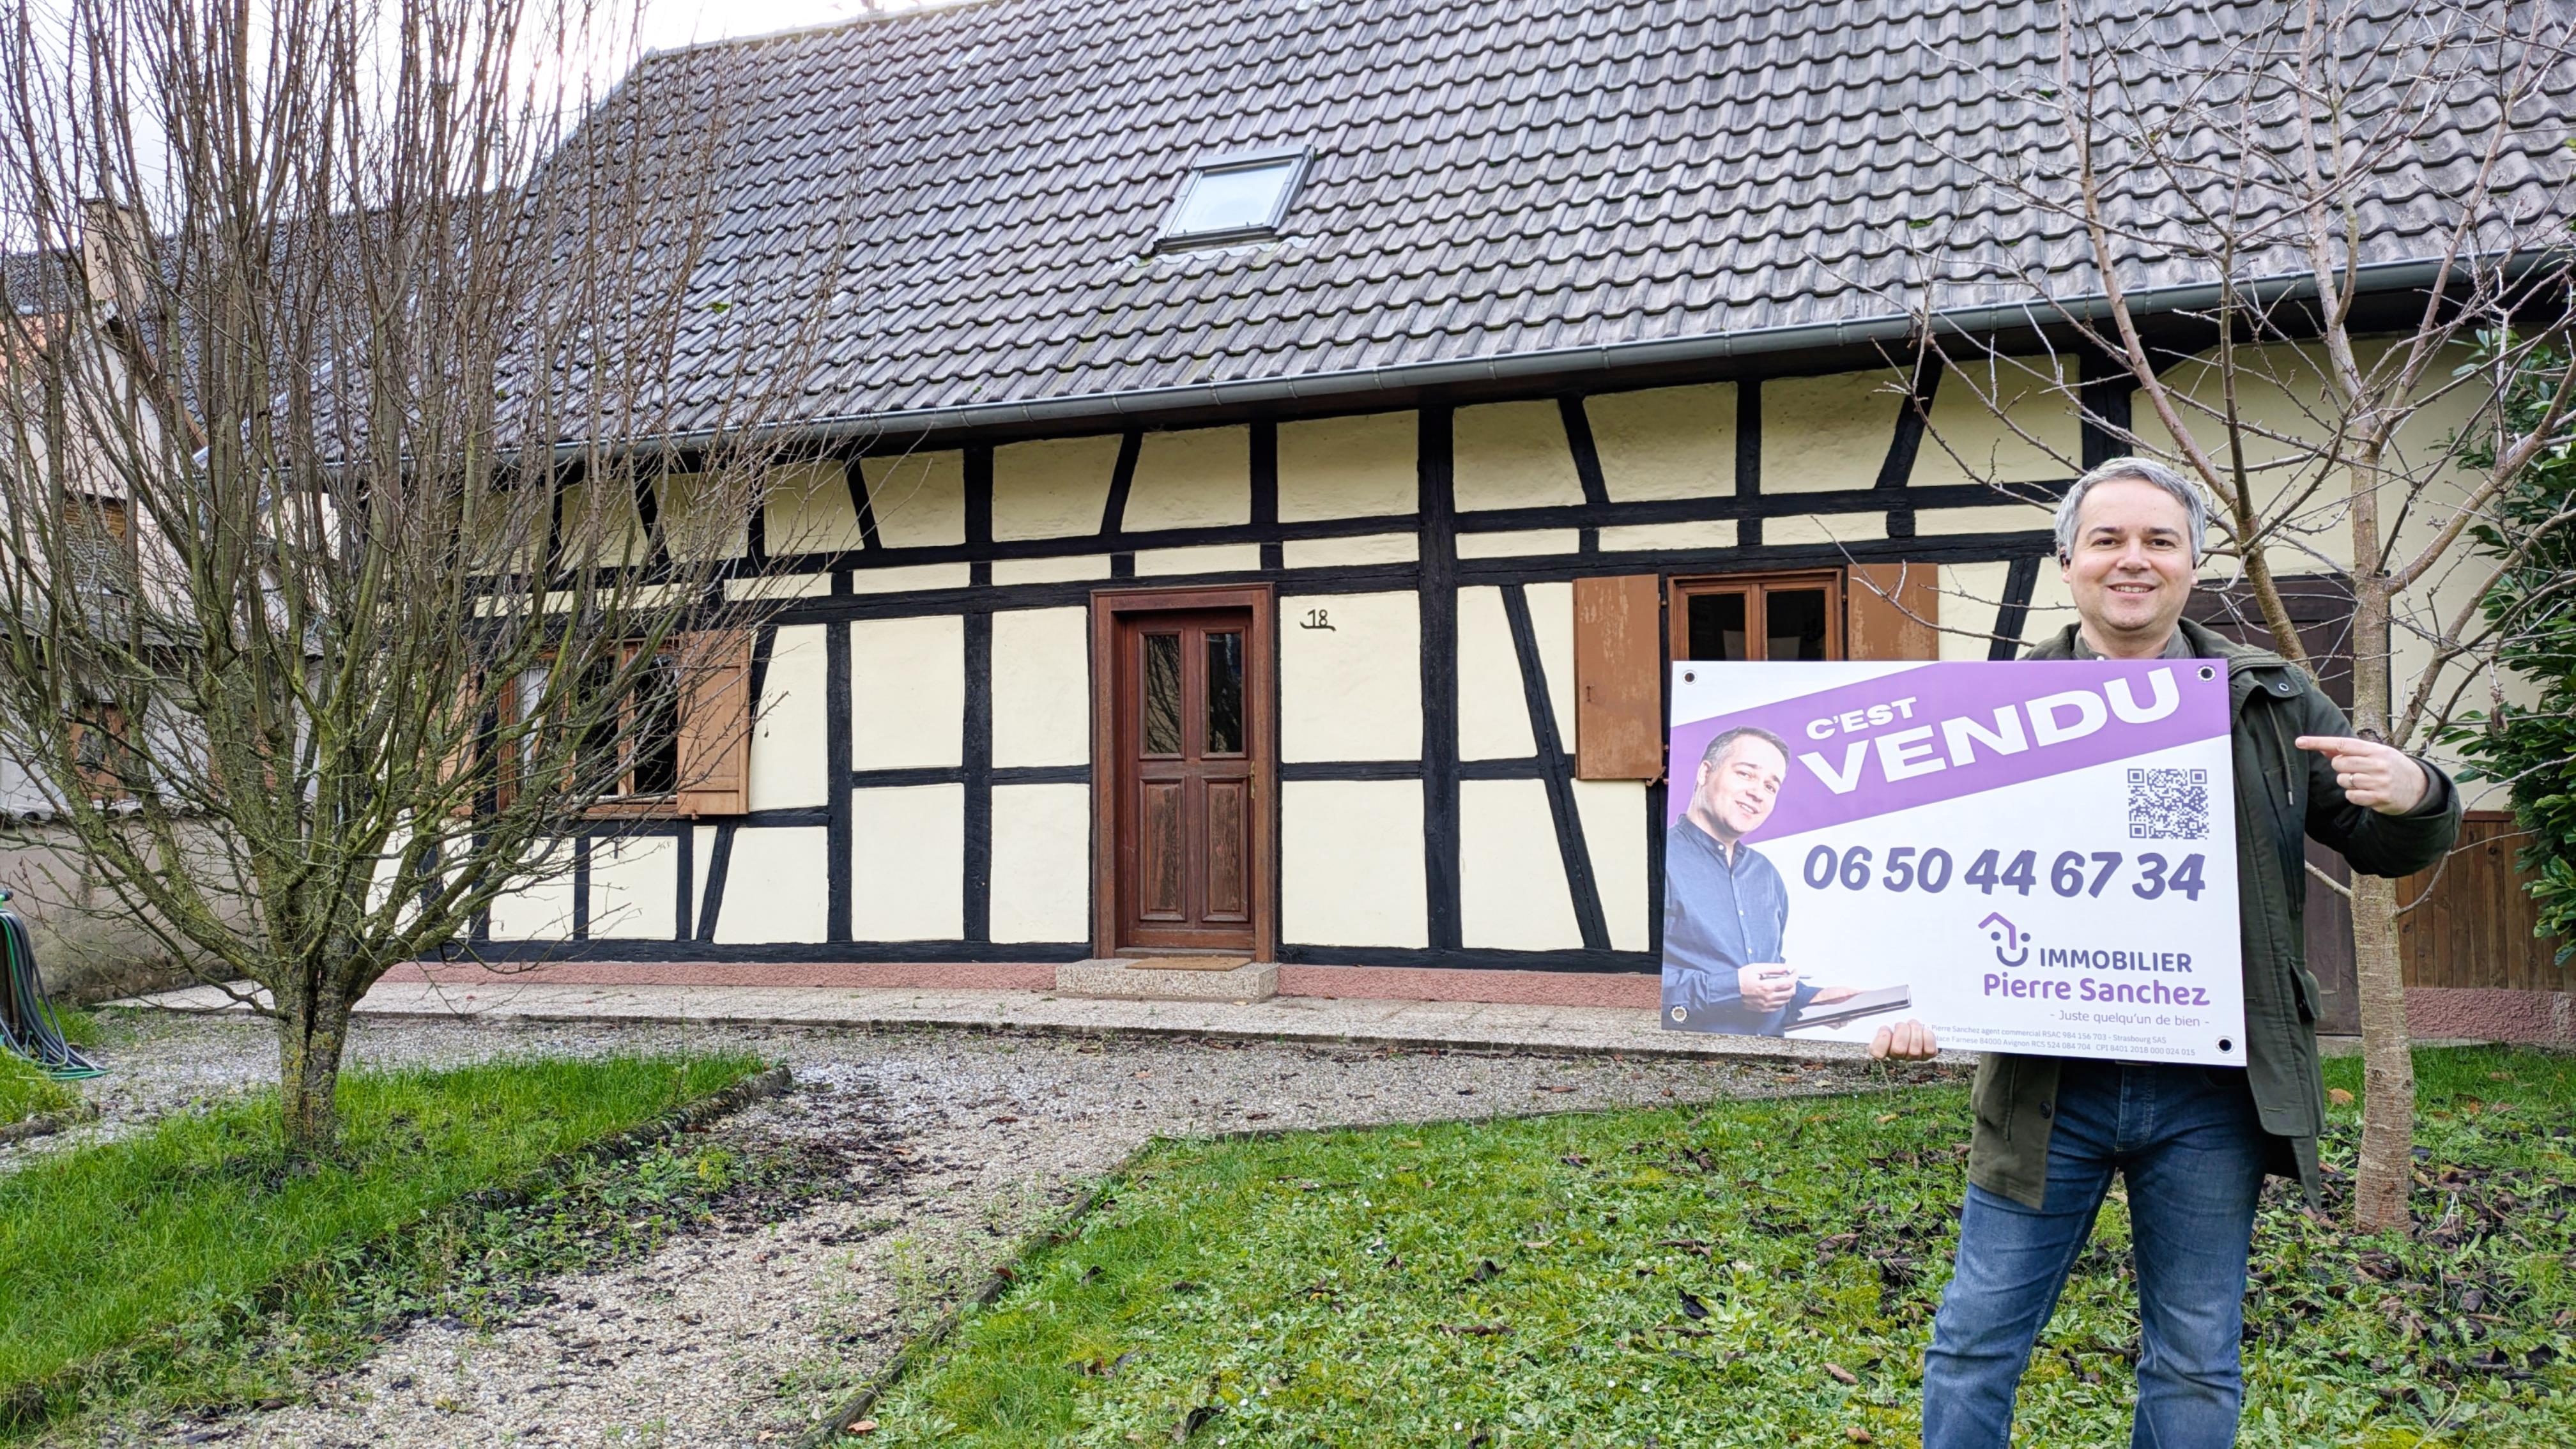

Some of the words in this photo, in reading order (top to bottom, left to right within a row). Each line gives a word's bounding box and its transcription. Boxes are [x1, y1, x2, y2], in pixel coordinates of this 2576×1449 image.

[1307, 608, 1328, 628] 18
[1797, 666, 2181, 795] VENDU
[1805, 696, 1917, 740] C'EST
[1803, 844, 1873, 891] 06
[1882, 847, 1953, 893] 50
[1964, 848, 2037, 896] 44
[2050, 850, 2123, 899] 67
[2131, 852, 2206, 901] 34
[2040, 947, 2193, 972] IMMOBILIER
[1984, 972, 2071, 1000] Pierre
[2080, 977, 2211, 1006] Sanchez
[2058, 1010, 2089, 1022] Juste
[2093, 1013, 2151, 1025] quelqu'un
[2156, 1015, 2170, 1025] de
[2175, 1015, 2200, 1027] bien
[1931, 1024, 1951, 1032] Pierre
[1952, 1026, 1980, 1034] Sanchez
[2113, 1034, 2151, 1044] Strasbourg
[2003, 1039, 2030, 1048] Avignon
